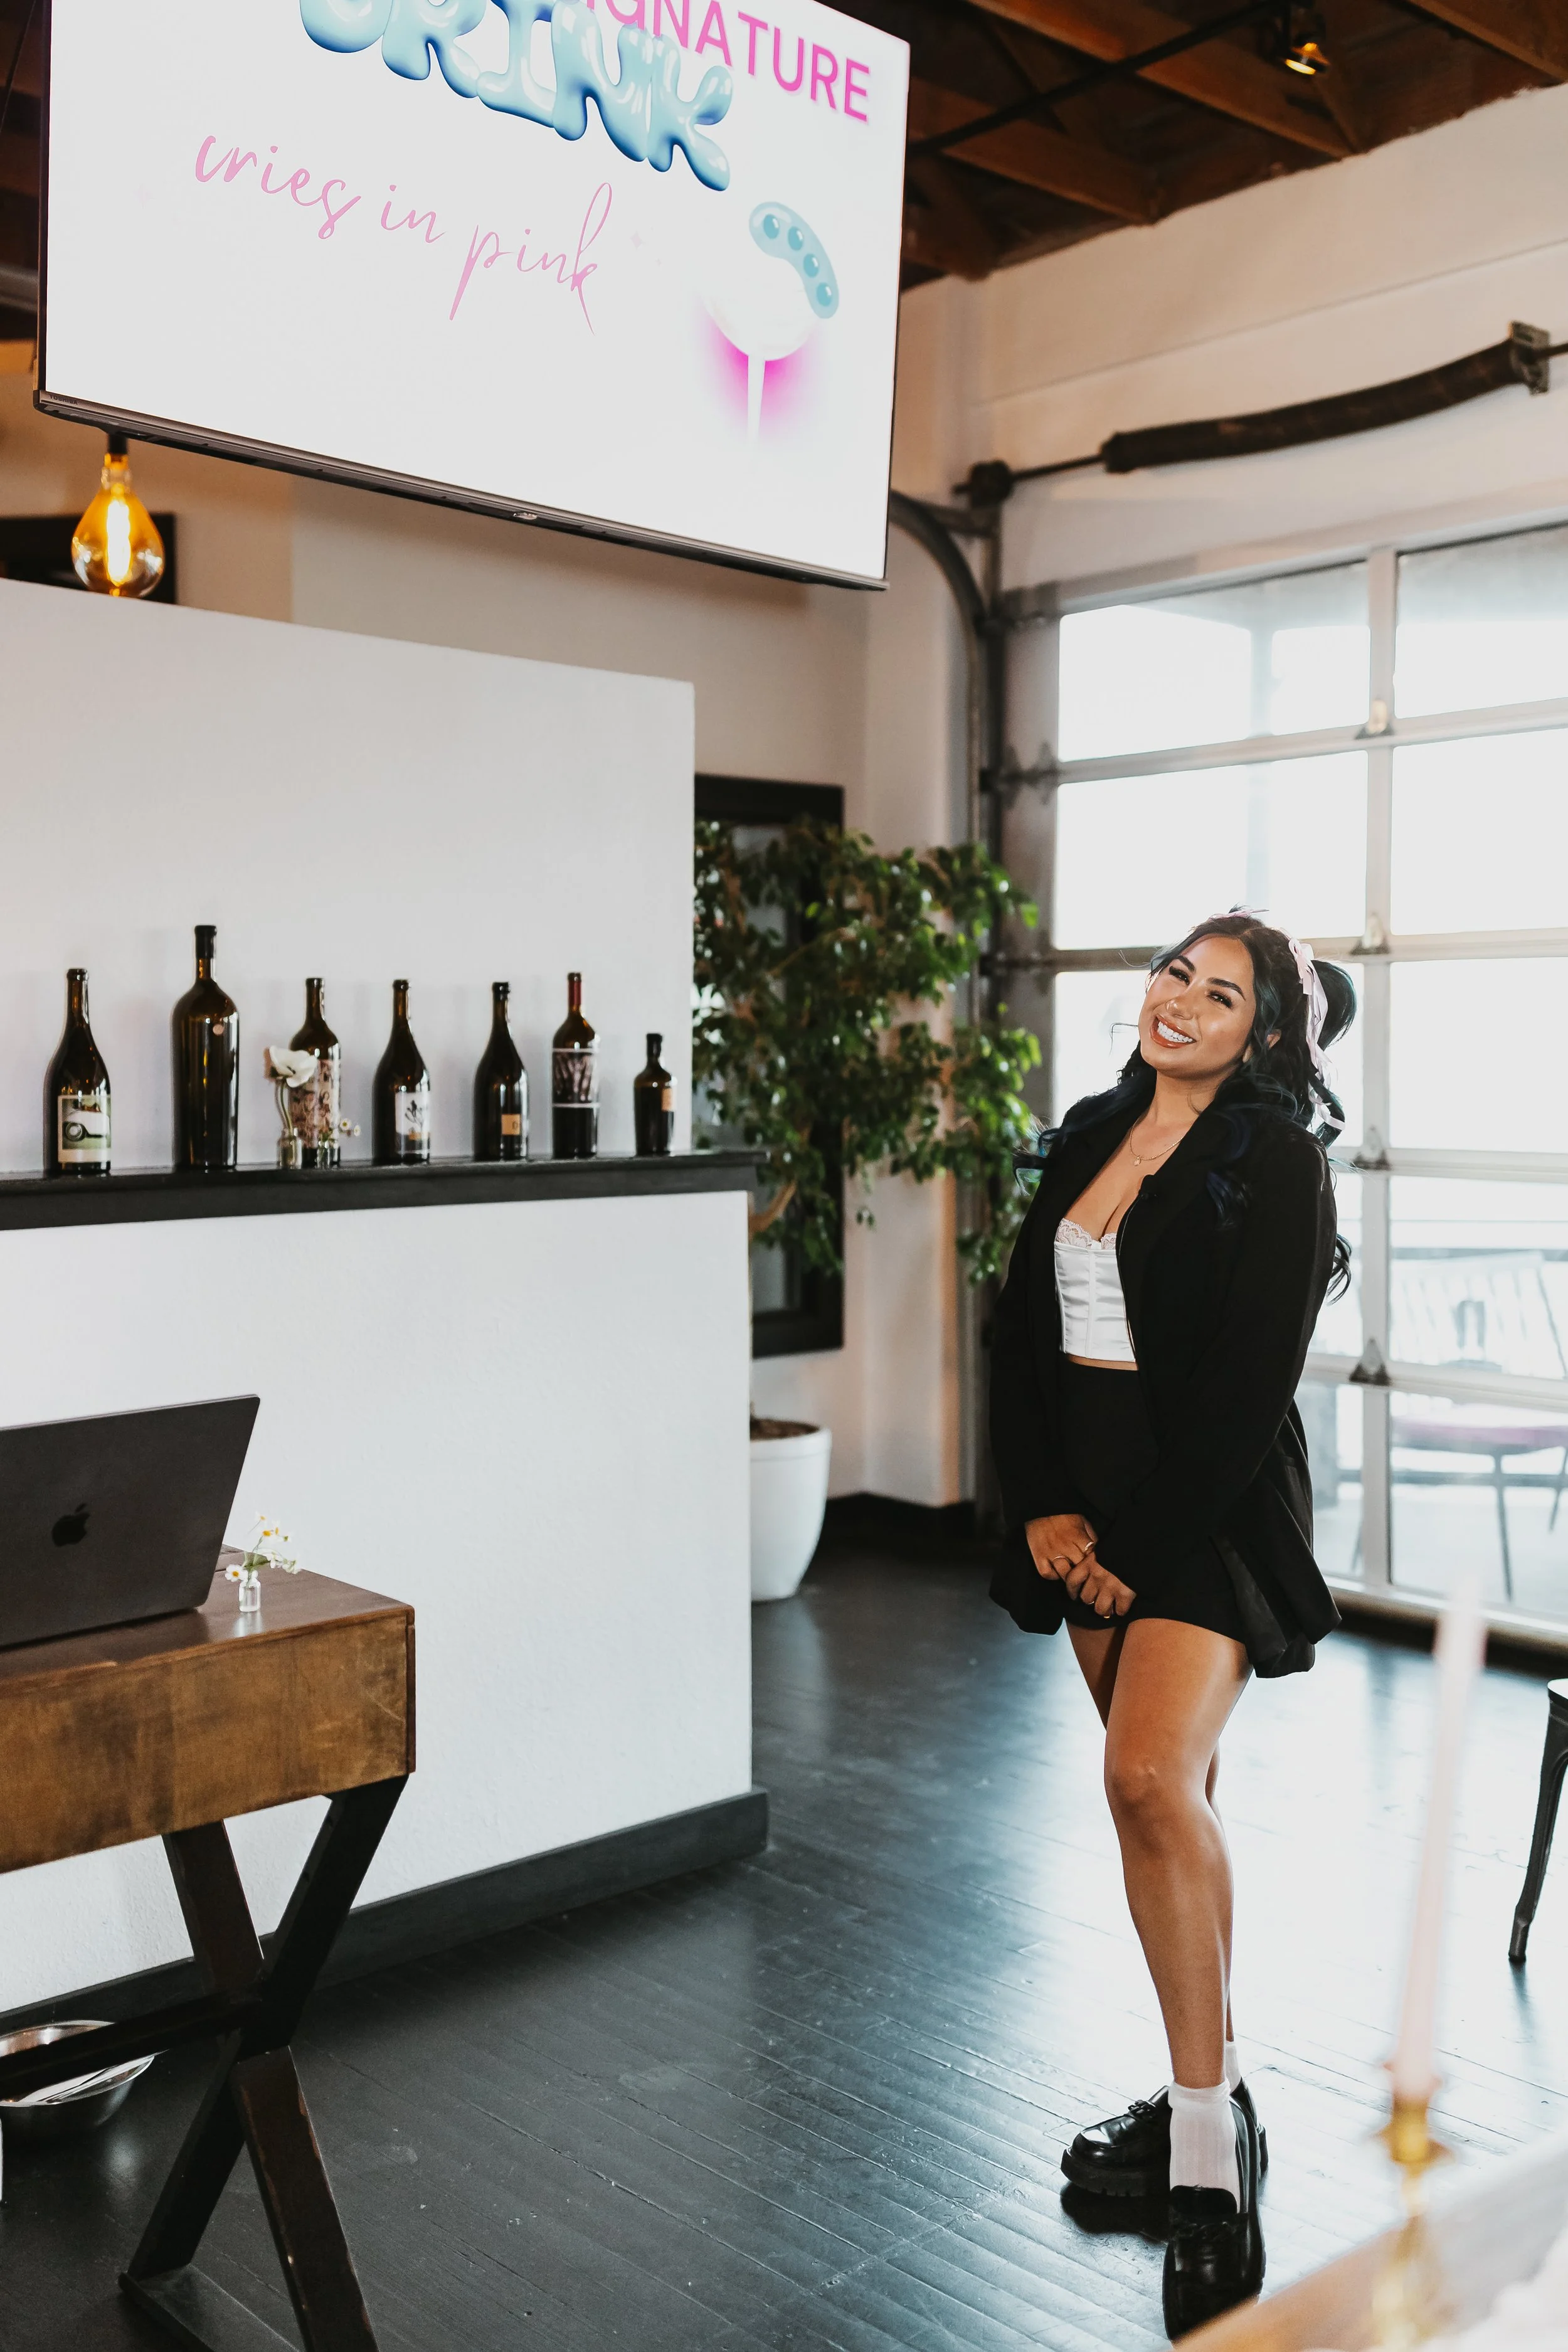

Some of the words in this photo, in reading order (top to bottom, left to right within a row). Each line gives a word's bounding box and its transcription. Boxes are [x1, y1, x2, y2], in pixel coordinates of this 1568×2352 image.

[586, 0, 871, 124] GNATURE
[195, 135, 361, 240] cries
[381, 184, 447, 243] in
[449, 182, 613, 336] pink
[50, 394, 78, 405] TOSHIBA
